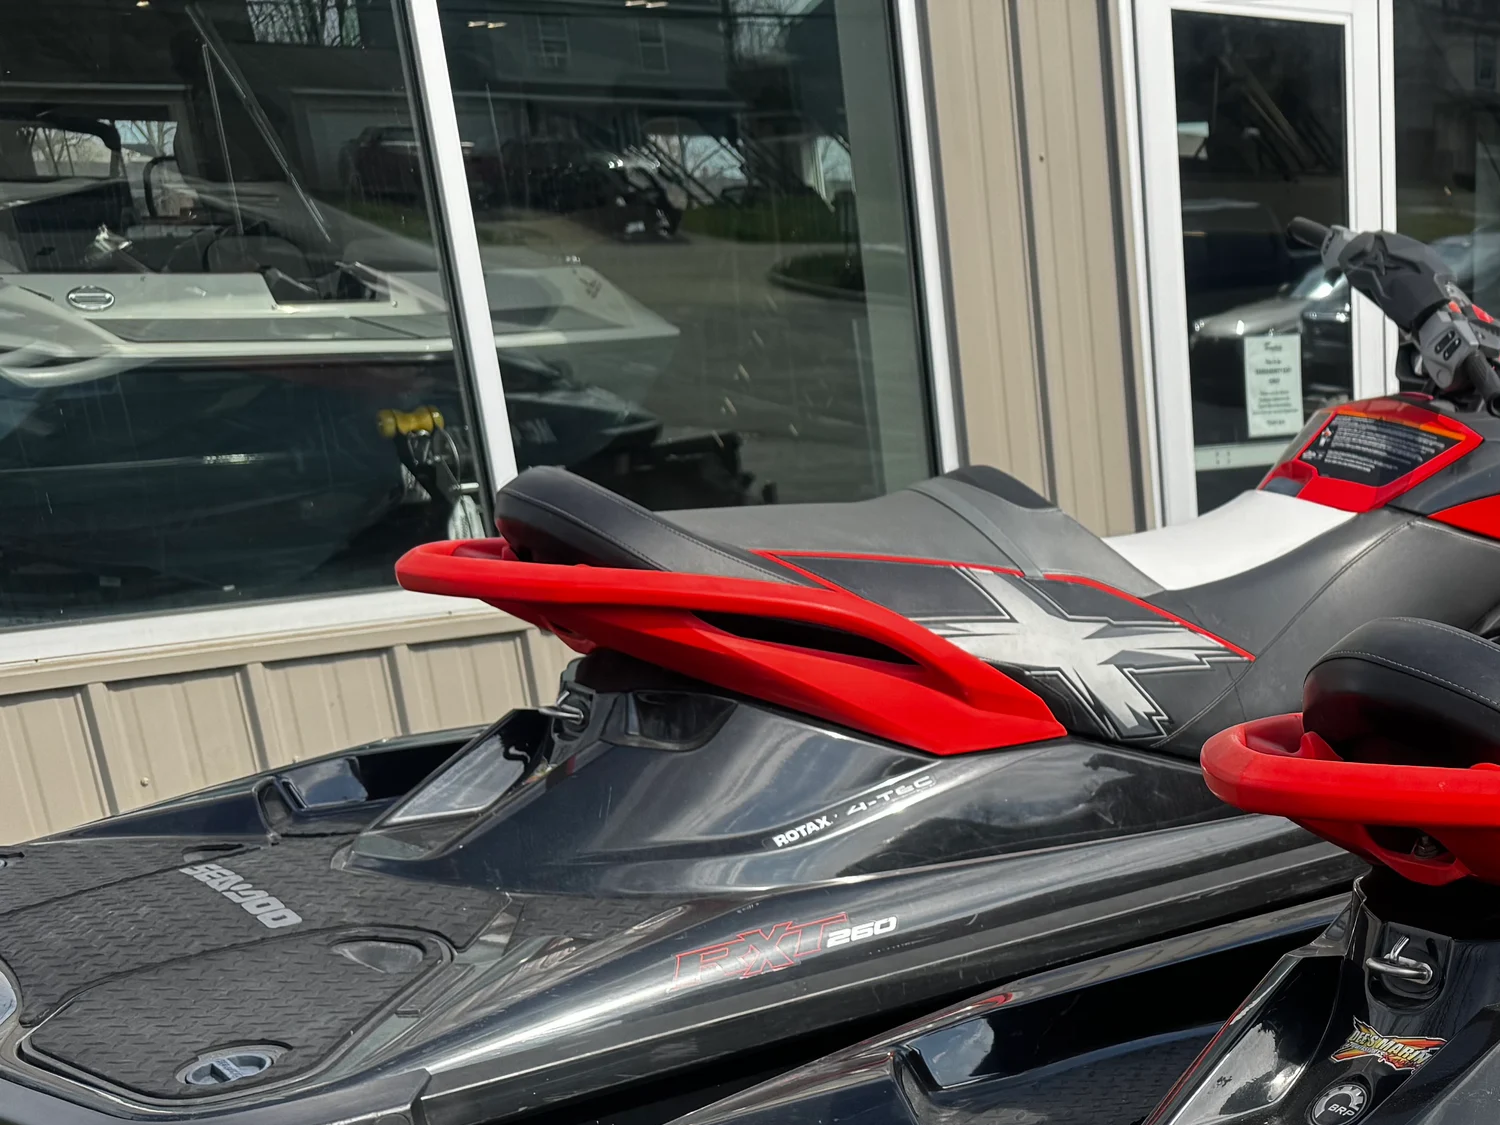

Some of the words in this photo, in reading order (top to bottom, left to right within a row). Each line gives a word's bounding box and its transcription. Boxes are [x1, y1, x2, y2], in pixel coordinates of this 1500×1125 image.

[773, 815, 834, 848] ROTAX
[846, 775, 937, 816] 4-TEC
[671, 911, 848, 991] RXT
[826, 916, 899, 949] 260
[1376, 1038, 1433, 1065] MARIN
[1328, 1102, 1355, 1117] BRP
